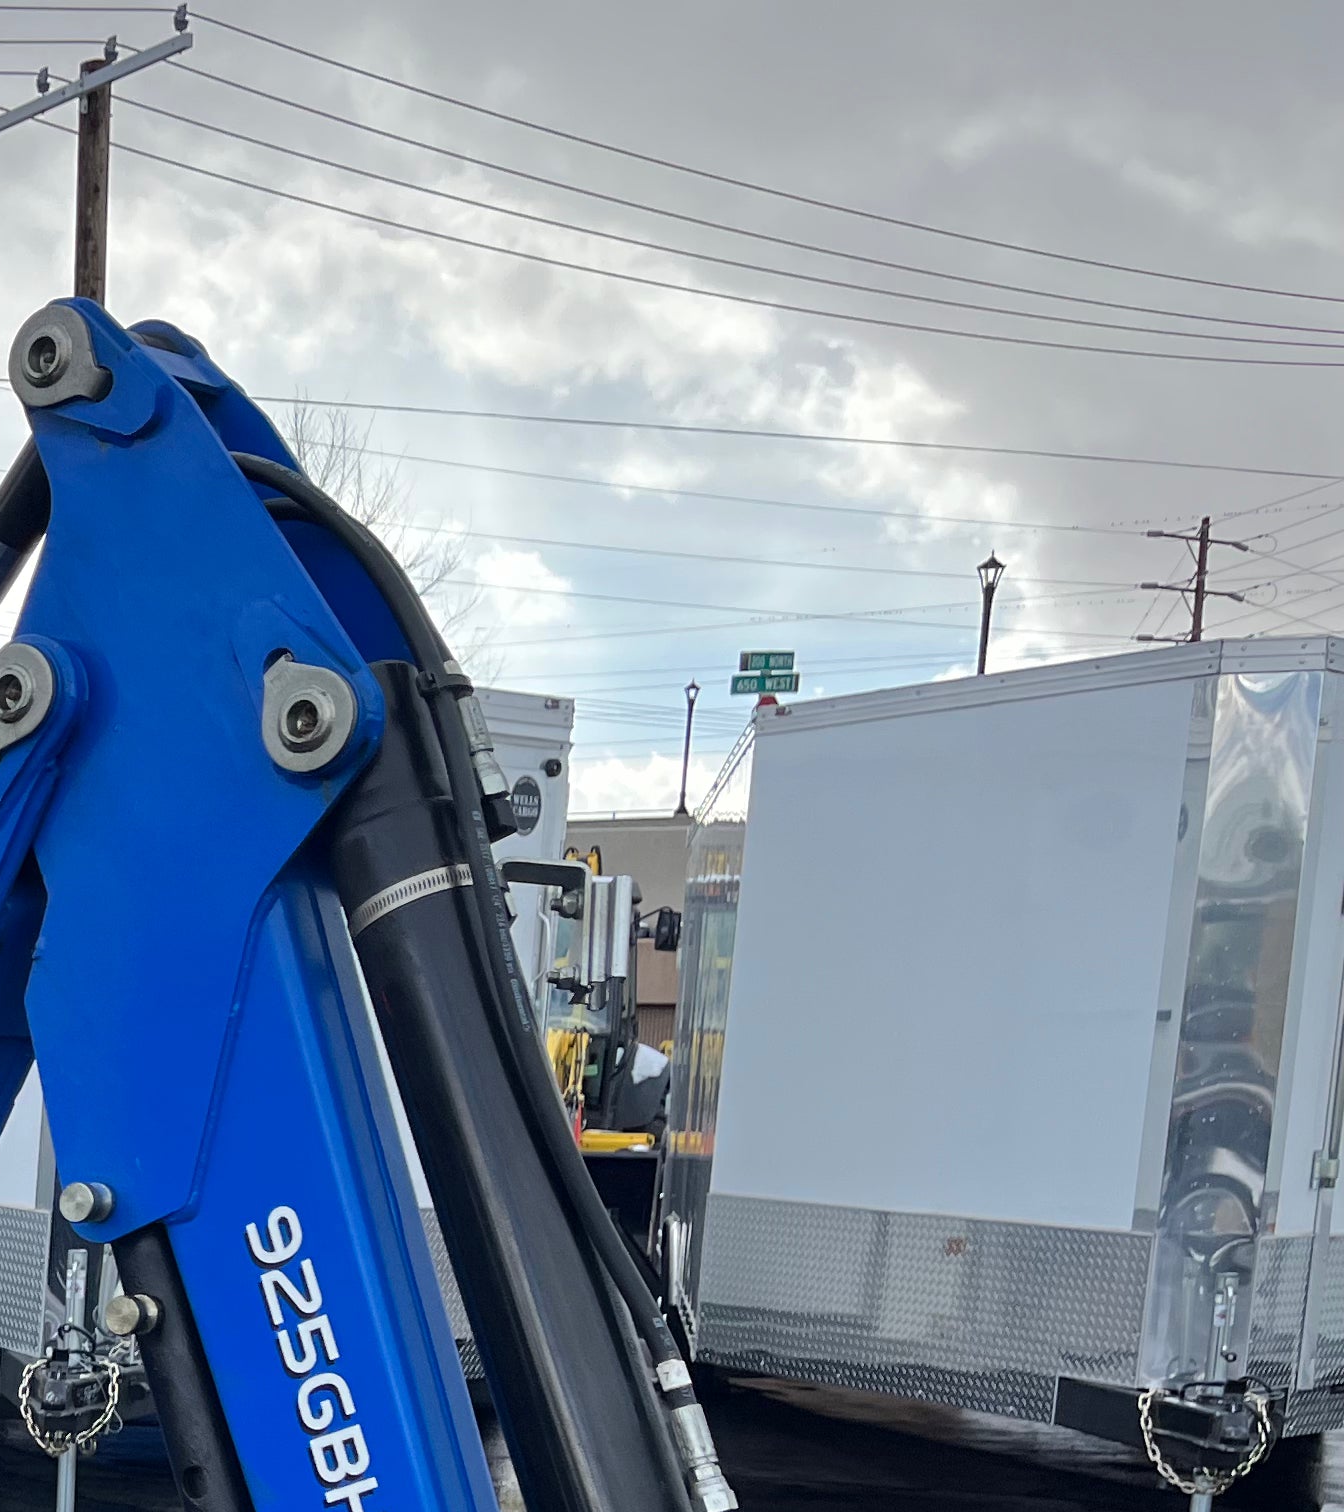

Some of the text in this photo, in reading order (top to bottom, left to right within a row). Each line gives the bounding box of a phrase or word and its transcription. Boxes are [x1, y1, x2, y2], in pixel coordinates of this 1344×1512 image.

[765, 676, 792, 691] WEST
[513, 794, 539, 806] WELLS
[513, 805, 539, 817] CARGO
